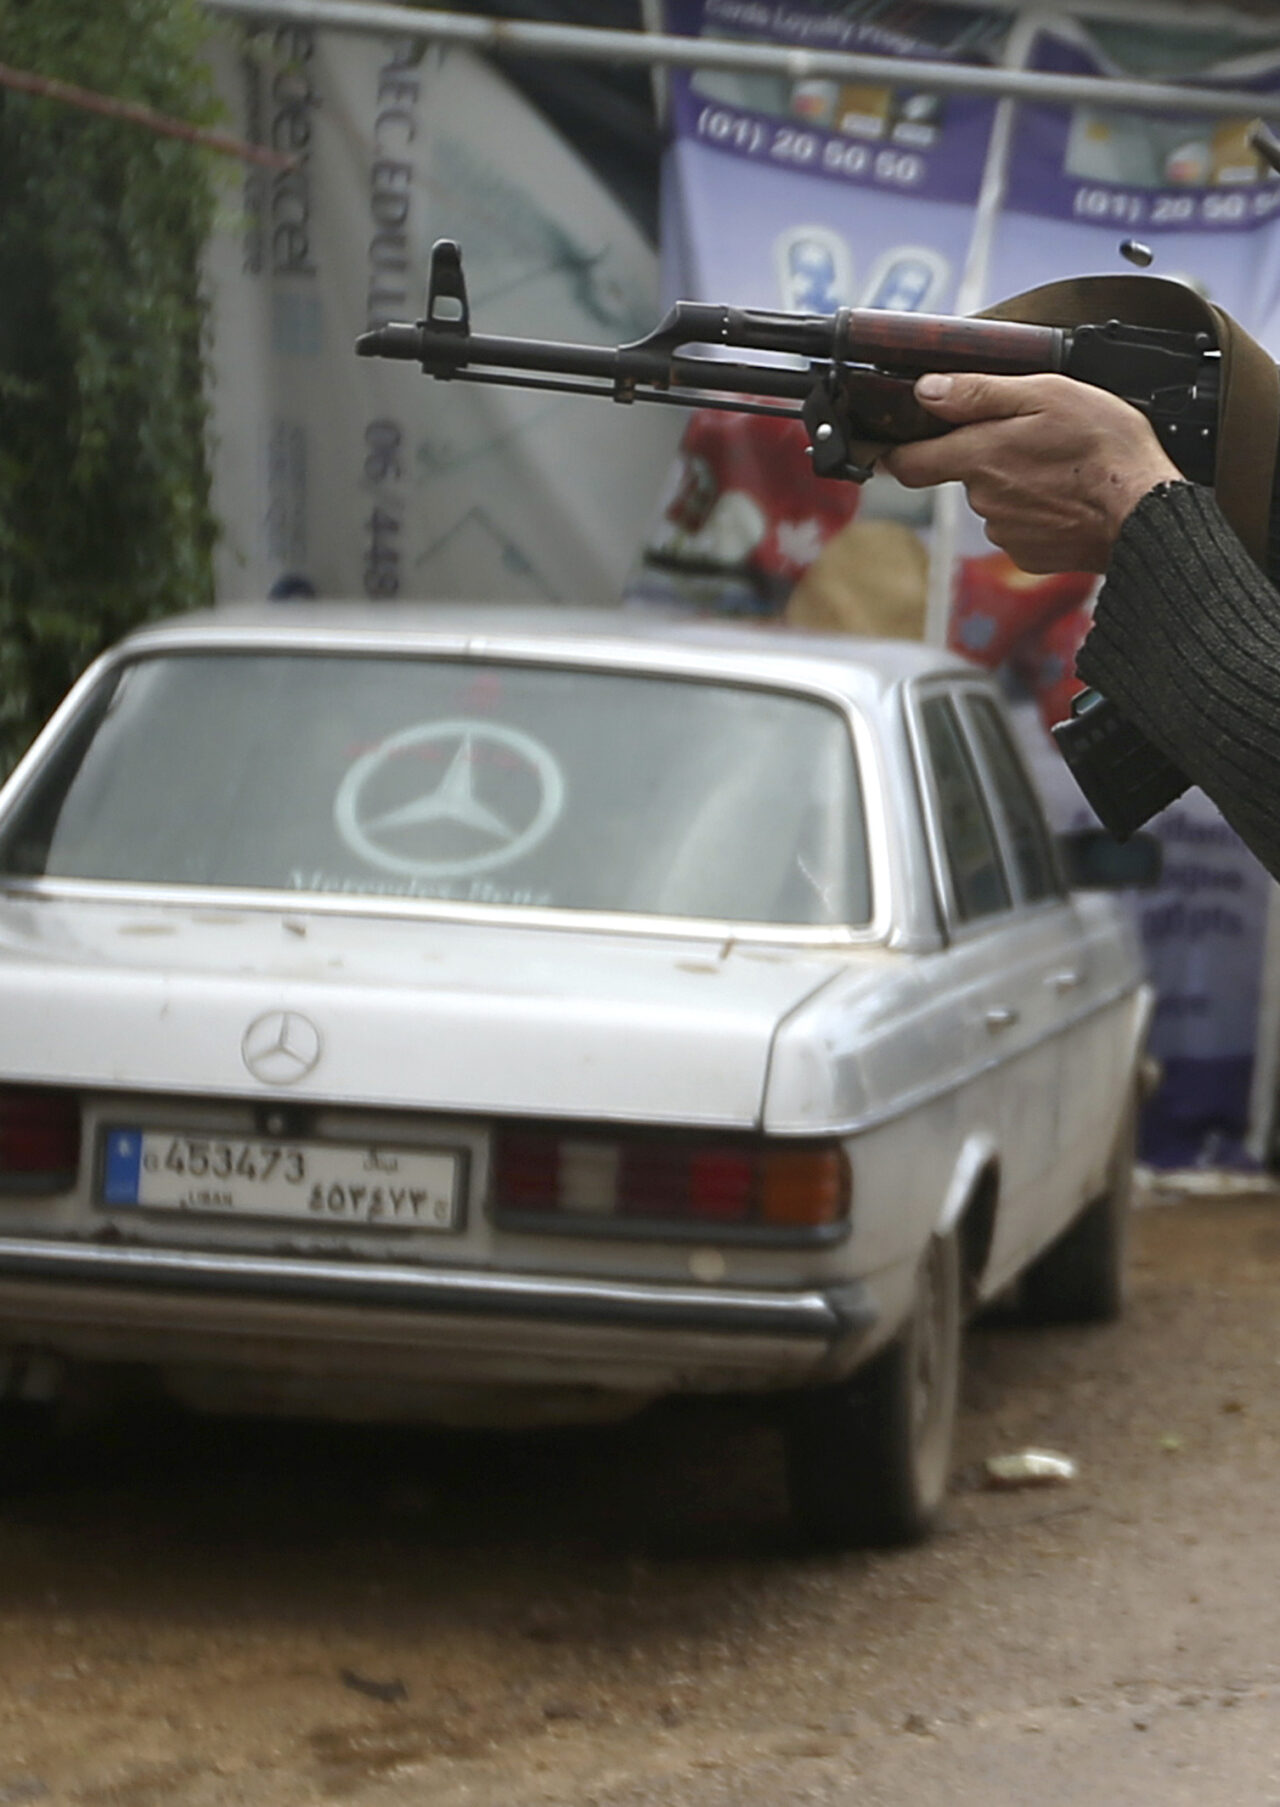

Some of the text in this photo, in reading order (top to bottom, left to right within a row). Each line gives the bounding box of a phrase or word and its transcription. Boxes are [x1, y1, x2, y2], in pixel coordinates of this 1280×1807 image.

[697, 105, 925, 185] (01) 20 50 50
[1073, 187, 1141, 225] (01)
[1151, 197, 1195, 226] 20
[164, 1136, 306, 1184] 453473
